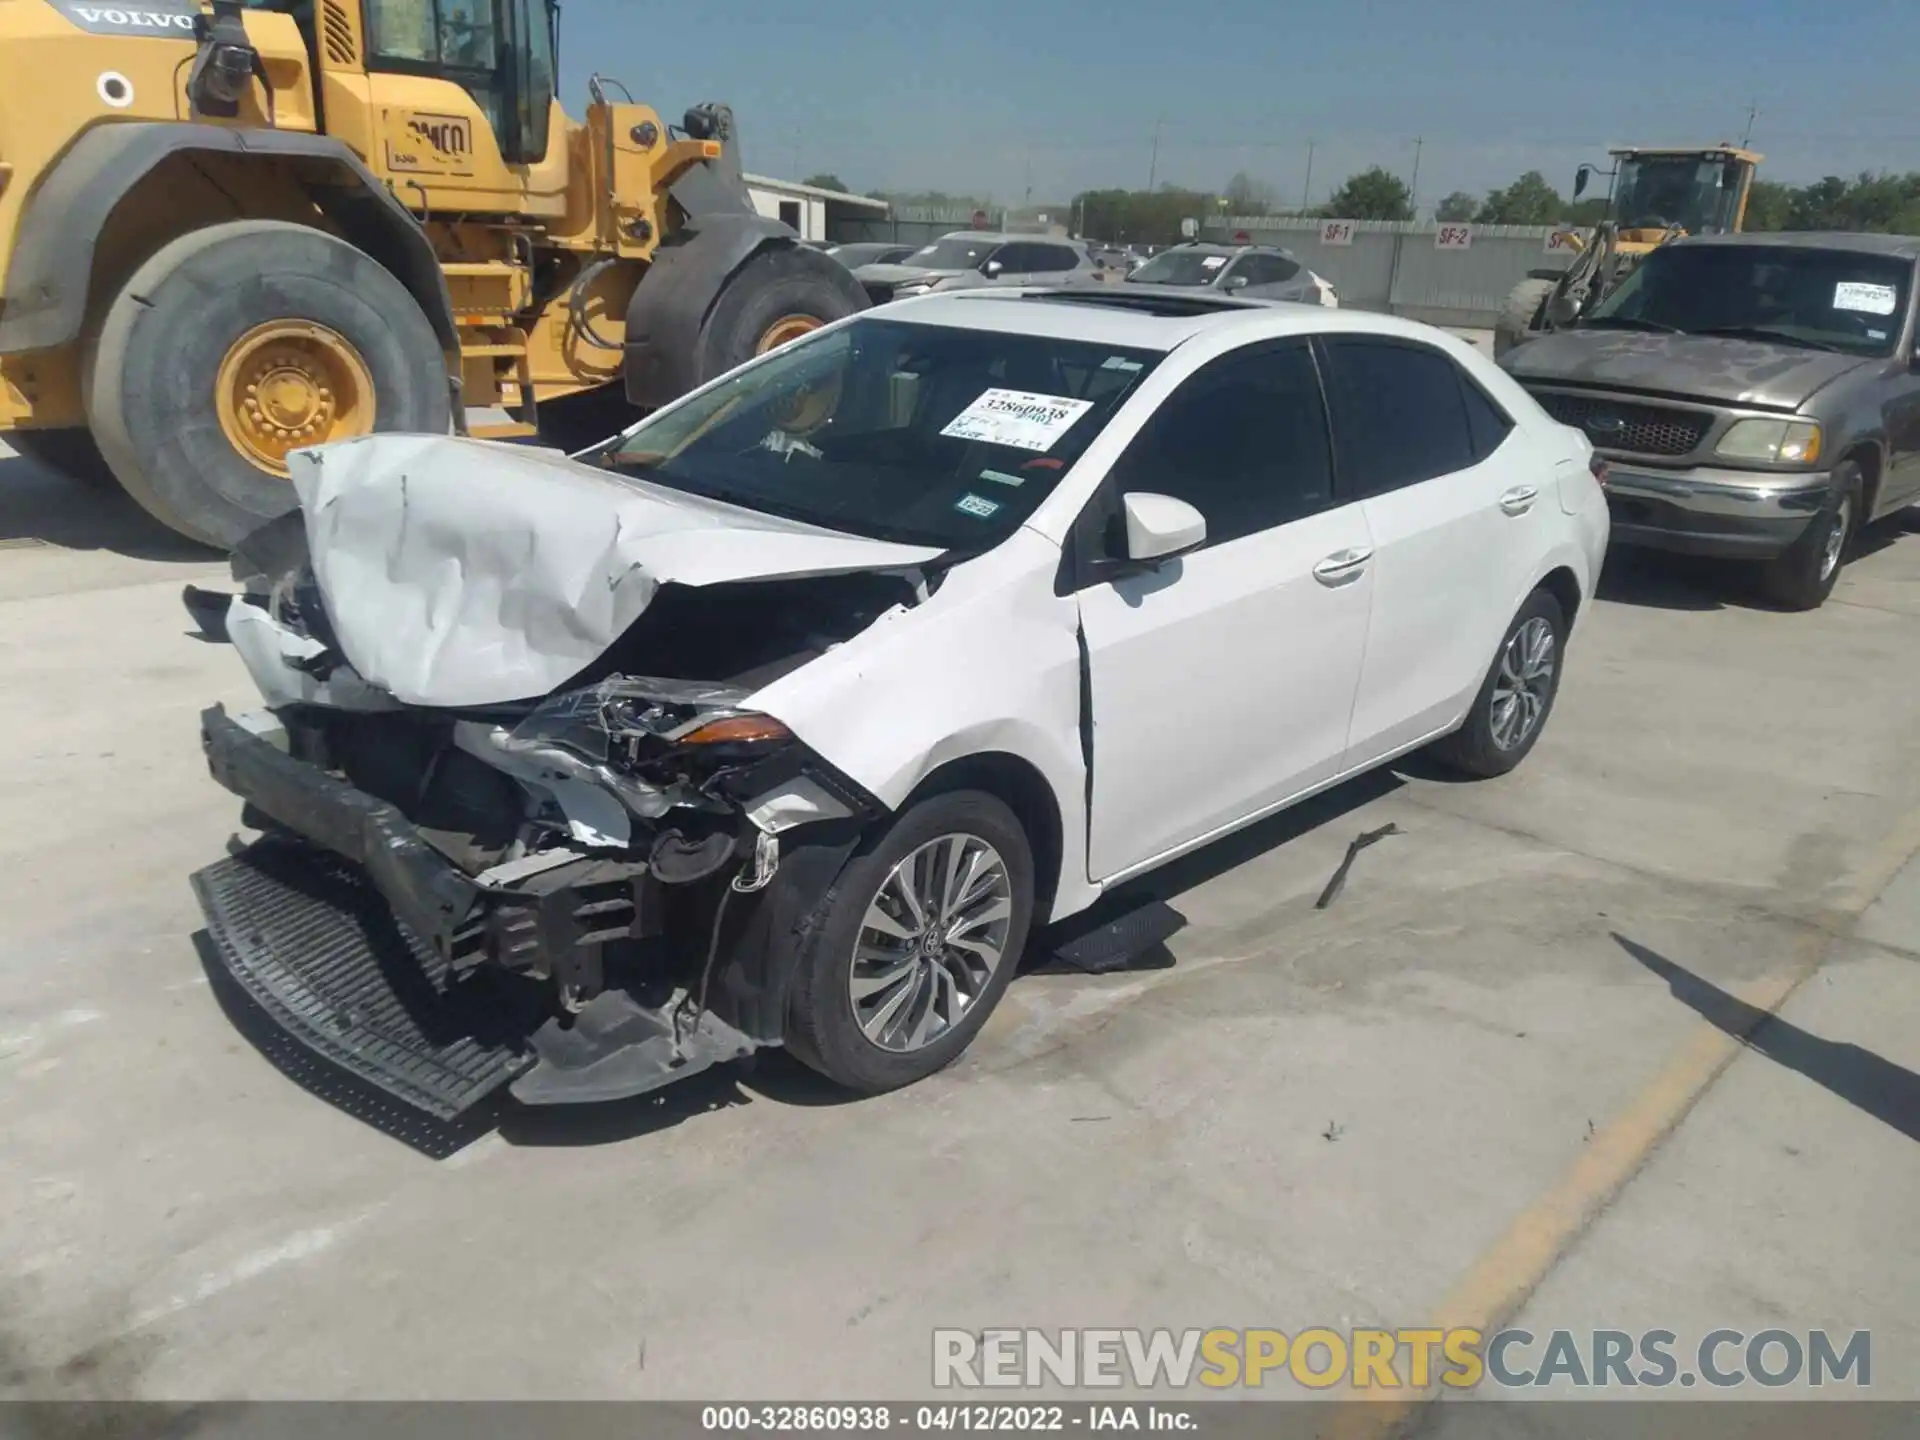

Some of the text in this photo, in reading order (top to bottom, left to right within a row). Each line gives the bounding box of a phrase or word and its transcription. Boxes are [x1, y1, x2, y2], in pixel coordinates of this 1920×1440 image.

[74, 7, 193, 29] VOLVO
[1325, 223, 1349, 240] SF-1
[1439, 227, 1469, 245] SF-2
[981, 399, 1069, 419] 32860938
